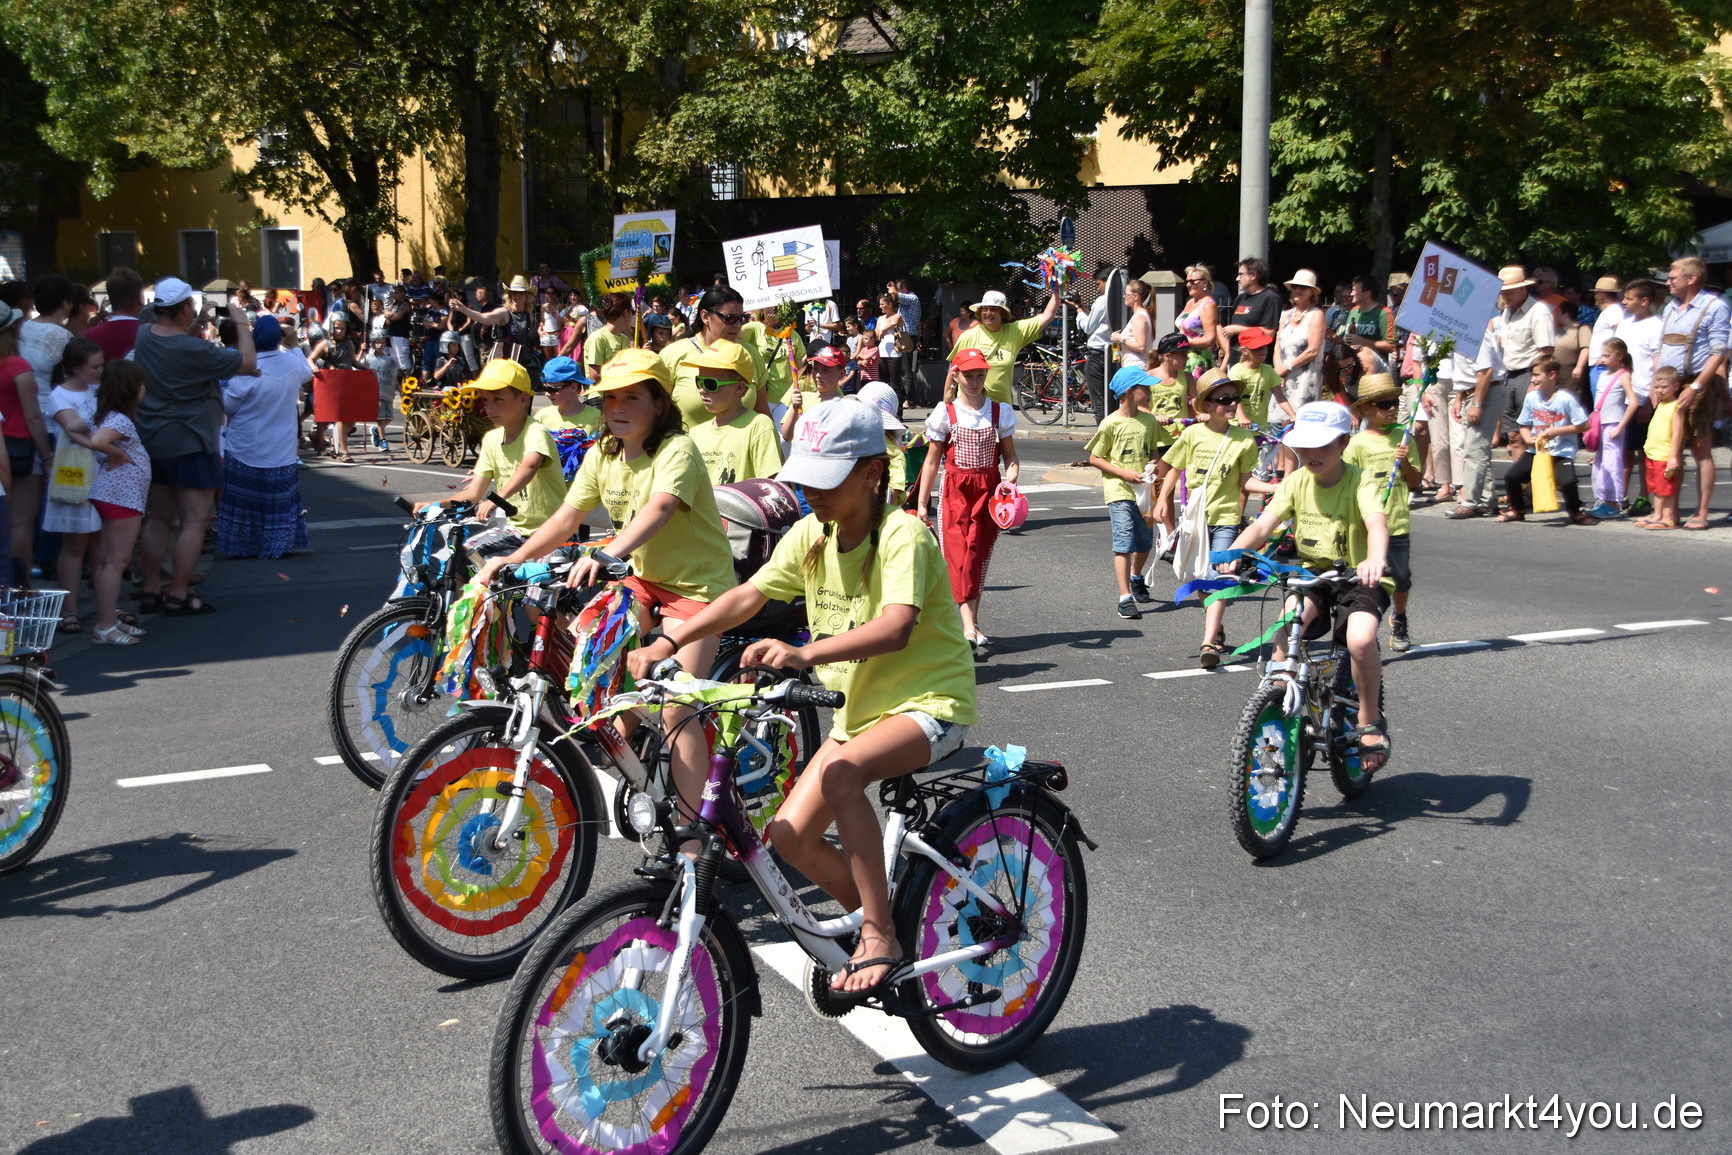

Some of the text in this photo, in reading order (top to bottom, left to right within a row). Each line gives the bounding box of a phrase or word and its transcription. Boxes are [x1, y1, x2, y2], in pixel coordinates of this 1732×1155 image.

[613, 247, 652, 259] Fairtrade
[730, 245, 747, 282] SINUS
[744, 286, 824, 306] Wir sind SINUSSCHULE
[1431, 307, 1469, 331] Bildung durch
[1427, 317, 1451, 333] Sprache
[1463, 334, 1480, 348] Schrift
[815, 600, 850, 614] Holzheim
